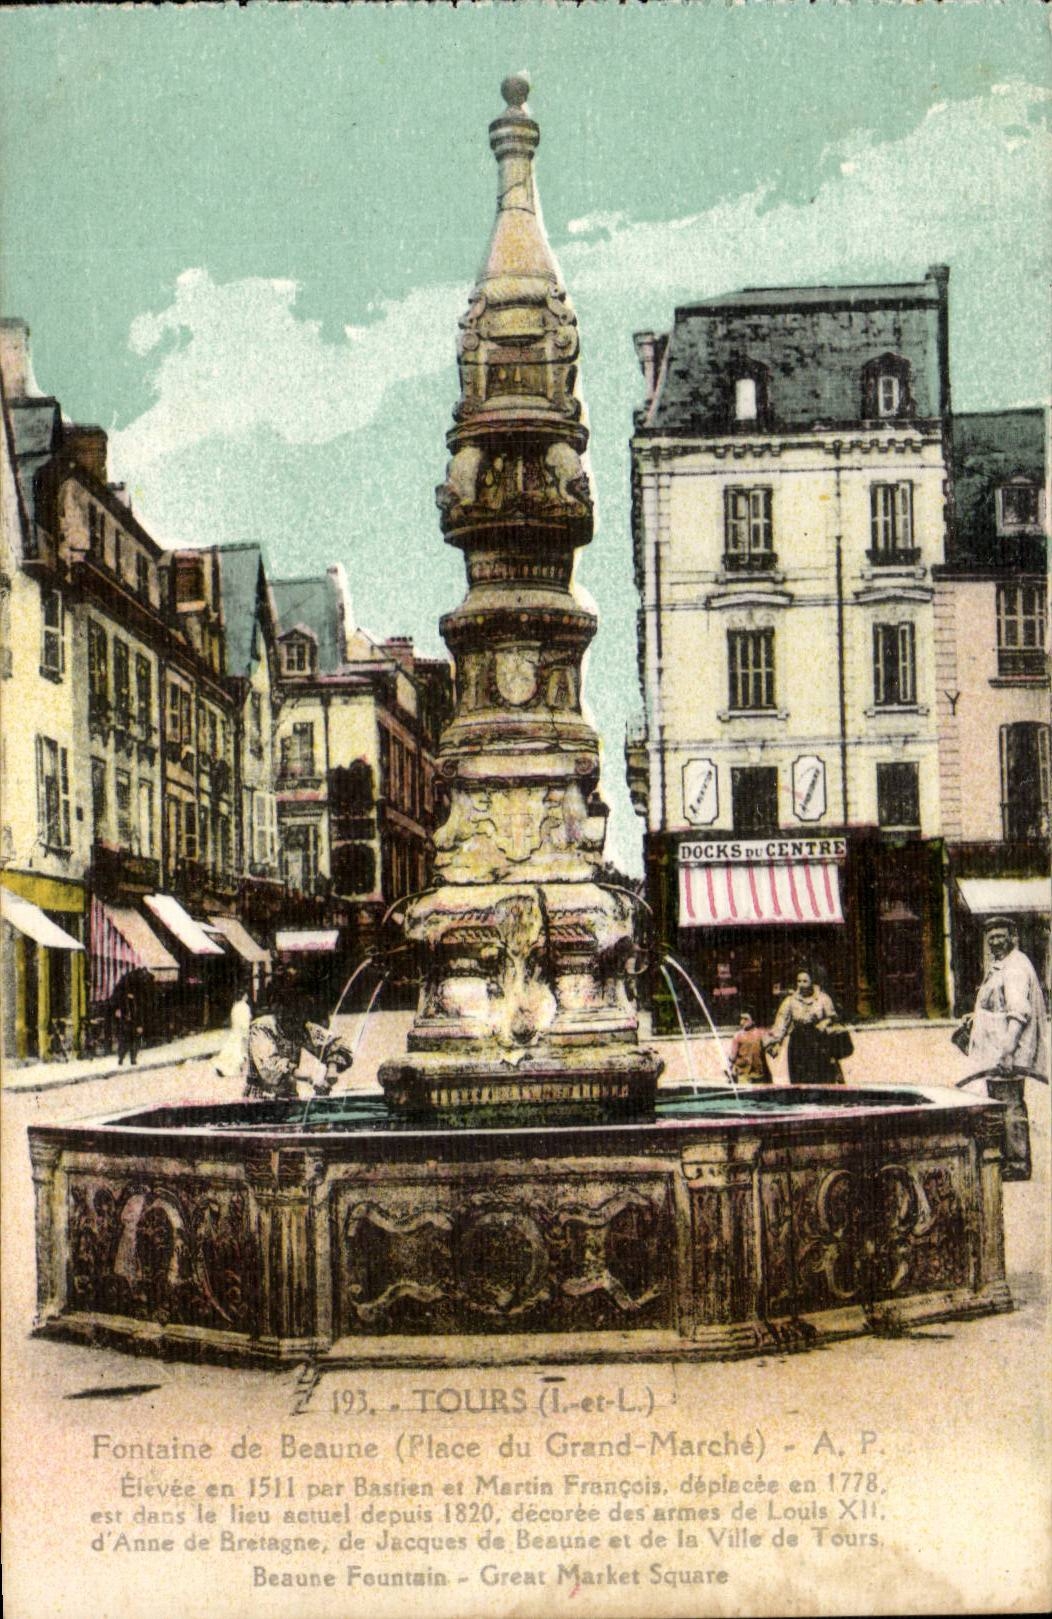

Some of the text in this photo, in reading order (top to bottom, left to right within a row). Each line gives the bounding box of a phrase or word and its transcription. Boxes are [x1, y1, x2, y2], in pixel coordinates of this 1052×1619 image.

[681, 840, 846, 859] DOCKS DU CENTRE
